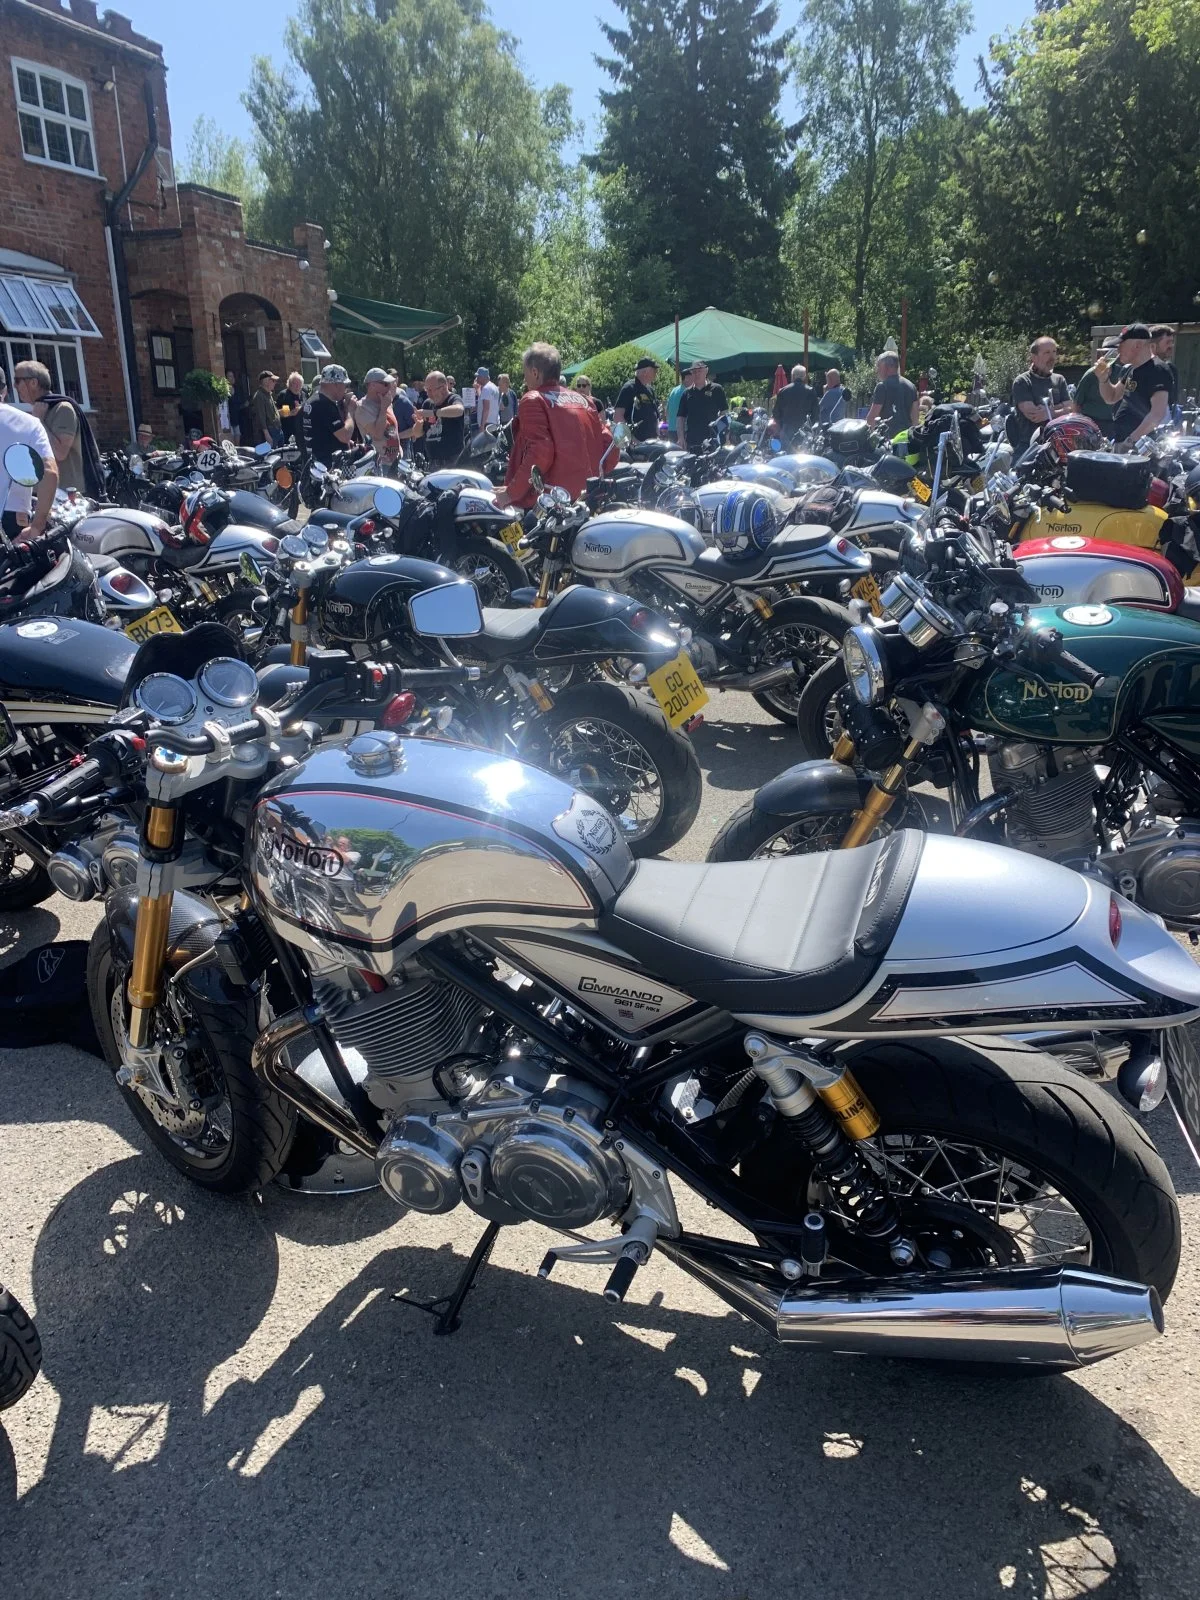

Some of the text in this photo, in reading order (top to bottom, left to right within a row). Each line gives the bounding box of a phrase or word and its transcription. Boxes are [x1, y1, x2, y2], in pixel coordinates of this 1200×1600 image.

[200, 452, 217, 467] 48
[1045, 523, 1082, 534] Norton
[584, 541, 612, 556] Norton
[1029, 583, 1065, 599] rton
[325, 598, 353, 617] Norton
[129, 611, 174, 644] BK73
[665, 671, 684, 693] GO
[1017, 678, 1093, 703] Norton
[267, 826, 344, 878] Norton
[578, 976, 664, 1005] COMMANDO
[614, 998, 633, 1008] 961
[836, 1098, 865, 1121] LINS
